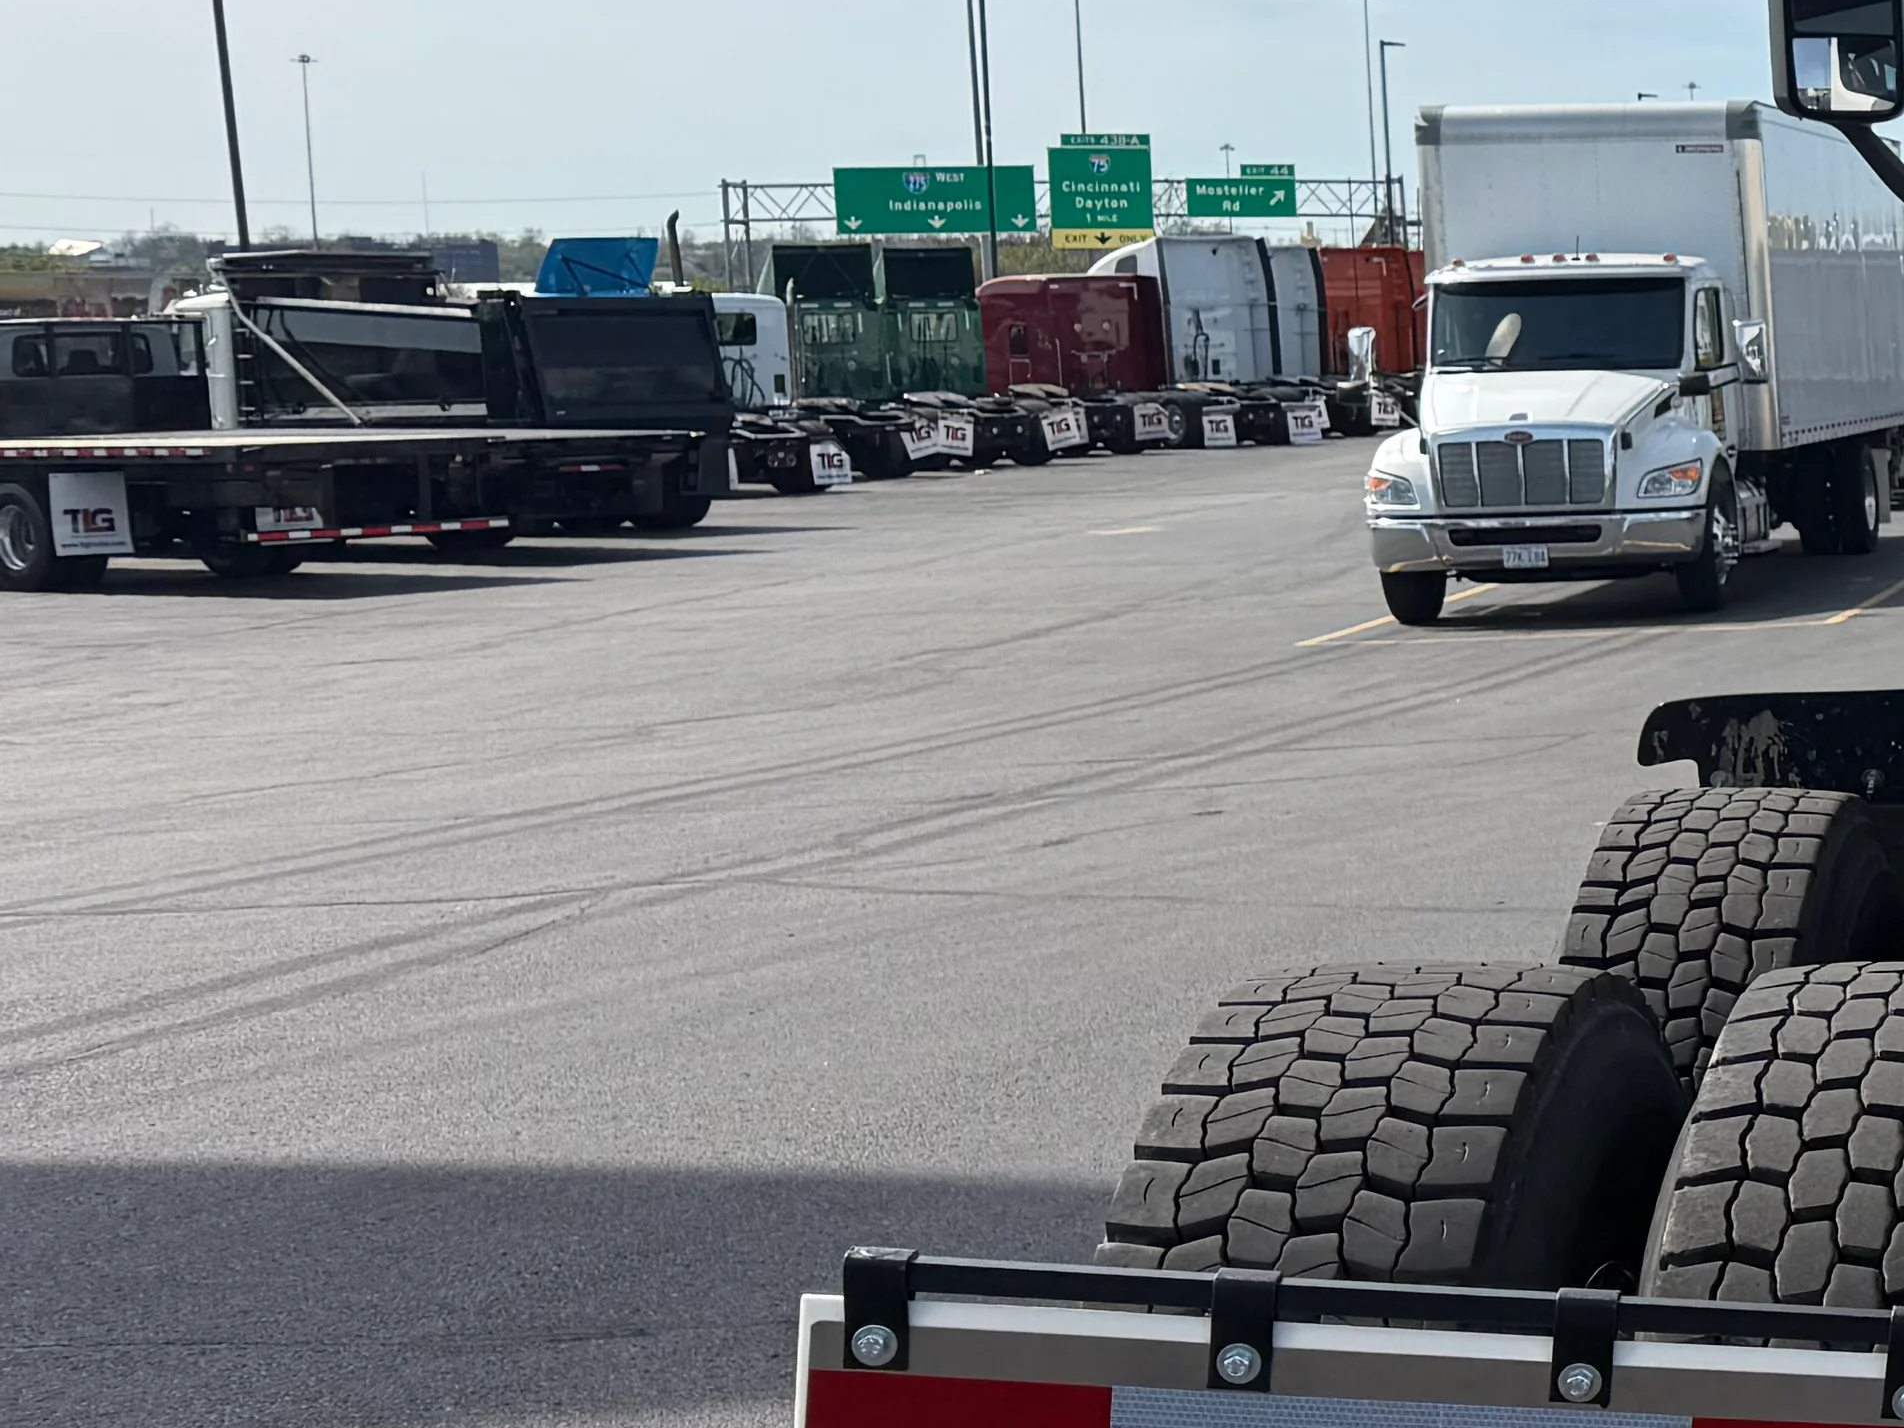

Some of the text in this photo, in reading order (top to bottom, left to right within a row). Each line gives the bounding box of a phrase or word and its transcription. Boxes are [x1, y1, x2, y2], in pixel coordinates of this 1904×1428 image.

[1092, 160, 1108, 172] 75
[1270, 166, 1289, 175] 44
[908, 176, 926, 192] 275
[935, 173, 965, 183] WEST
[1062, 181, 1141, 193] Cincinnati
[1196, 184, 1264, 196] Mosteller
[889, 199, 982, 212] Indianapolis
[1075, 197, 1128, 212] Dayton
[1222, 200, 1240, 212] Rd
[1097, 215, 1118, 223] MILE
[1065, 234, 1087, 243] EXIT
[1139, 412, 1162, 428] TLG
[1047, 417, 1071, 436] TLG
[943, 424, 967, 442] TLG
[817, 452, 844, 469] TLG
[63, 507, 116, 534] TLG
